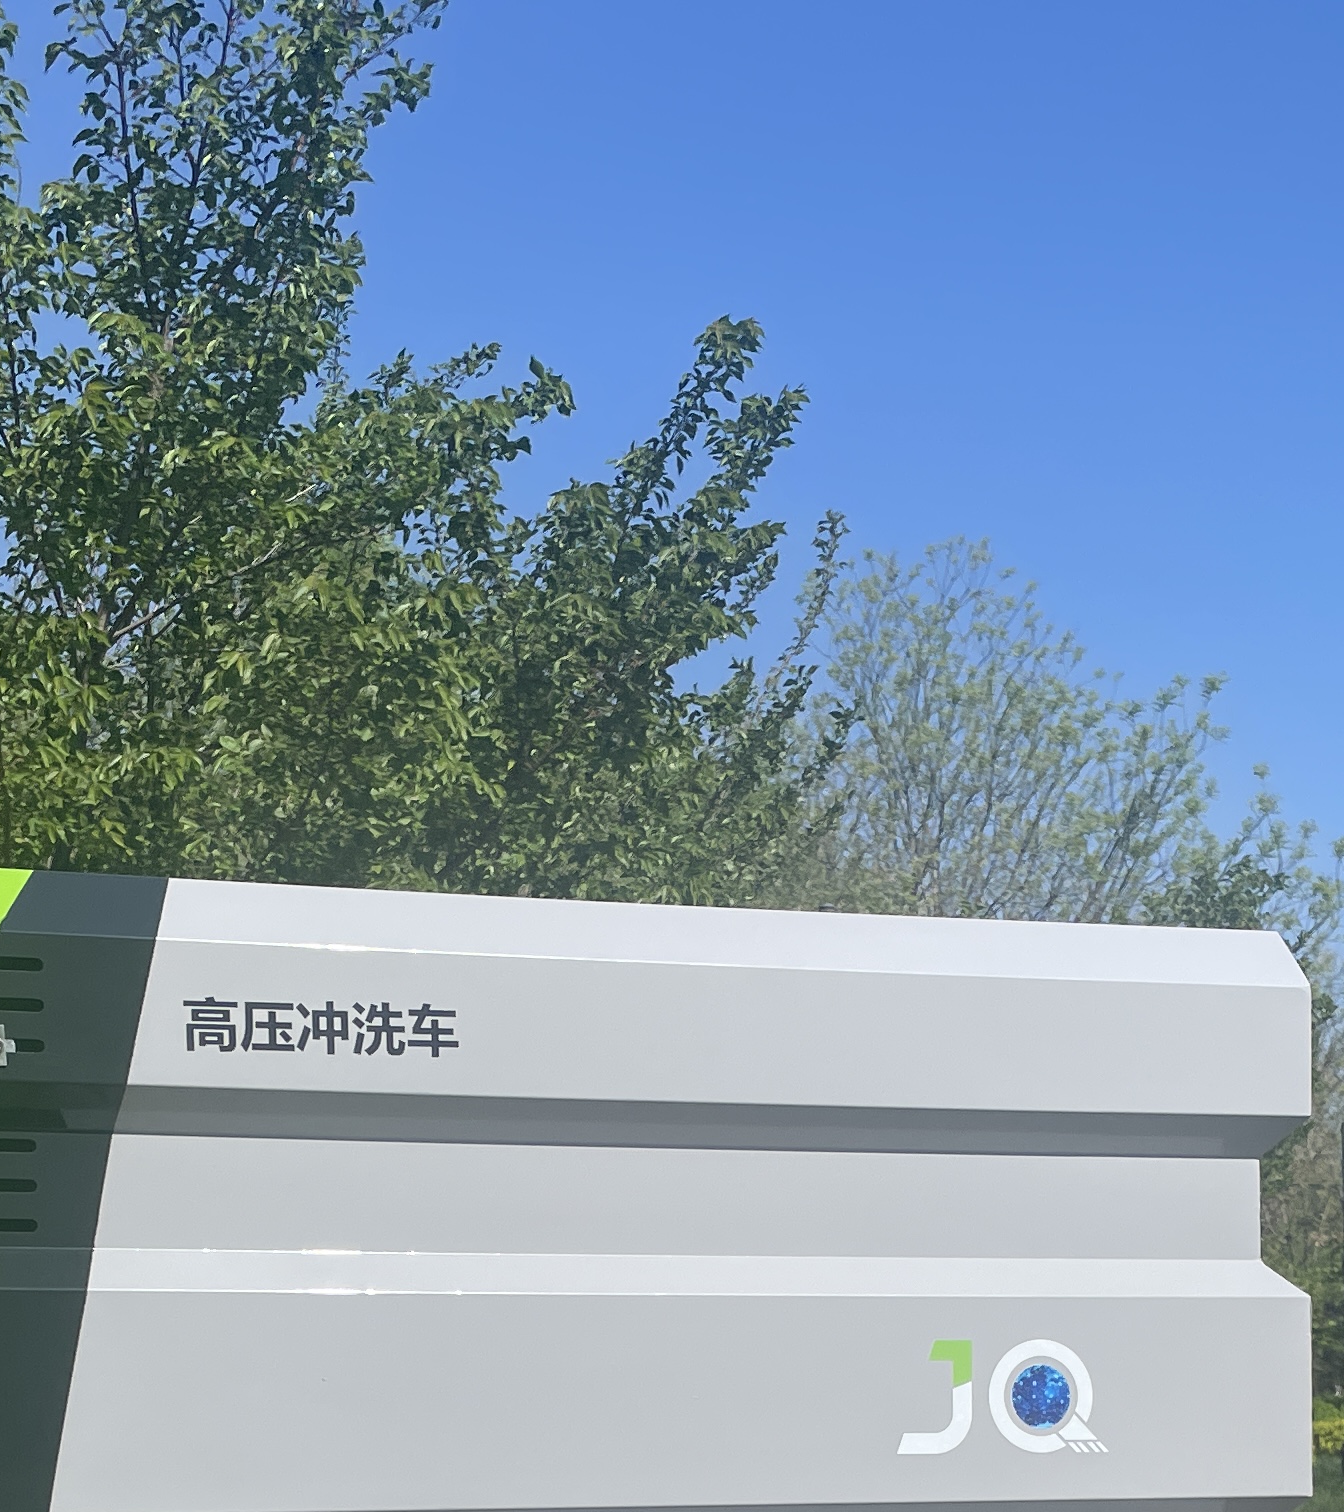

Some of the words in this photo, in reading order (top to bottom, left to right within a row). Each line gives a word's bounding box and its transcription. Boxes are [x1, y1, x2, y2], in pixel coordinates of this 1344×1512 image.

[183, 996, 459, 1057] 高压冲洗车
[897, 1339, 1109, 1454] JQ
